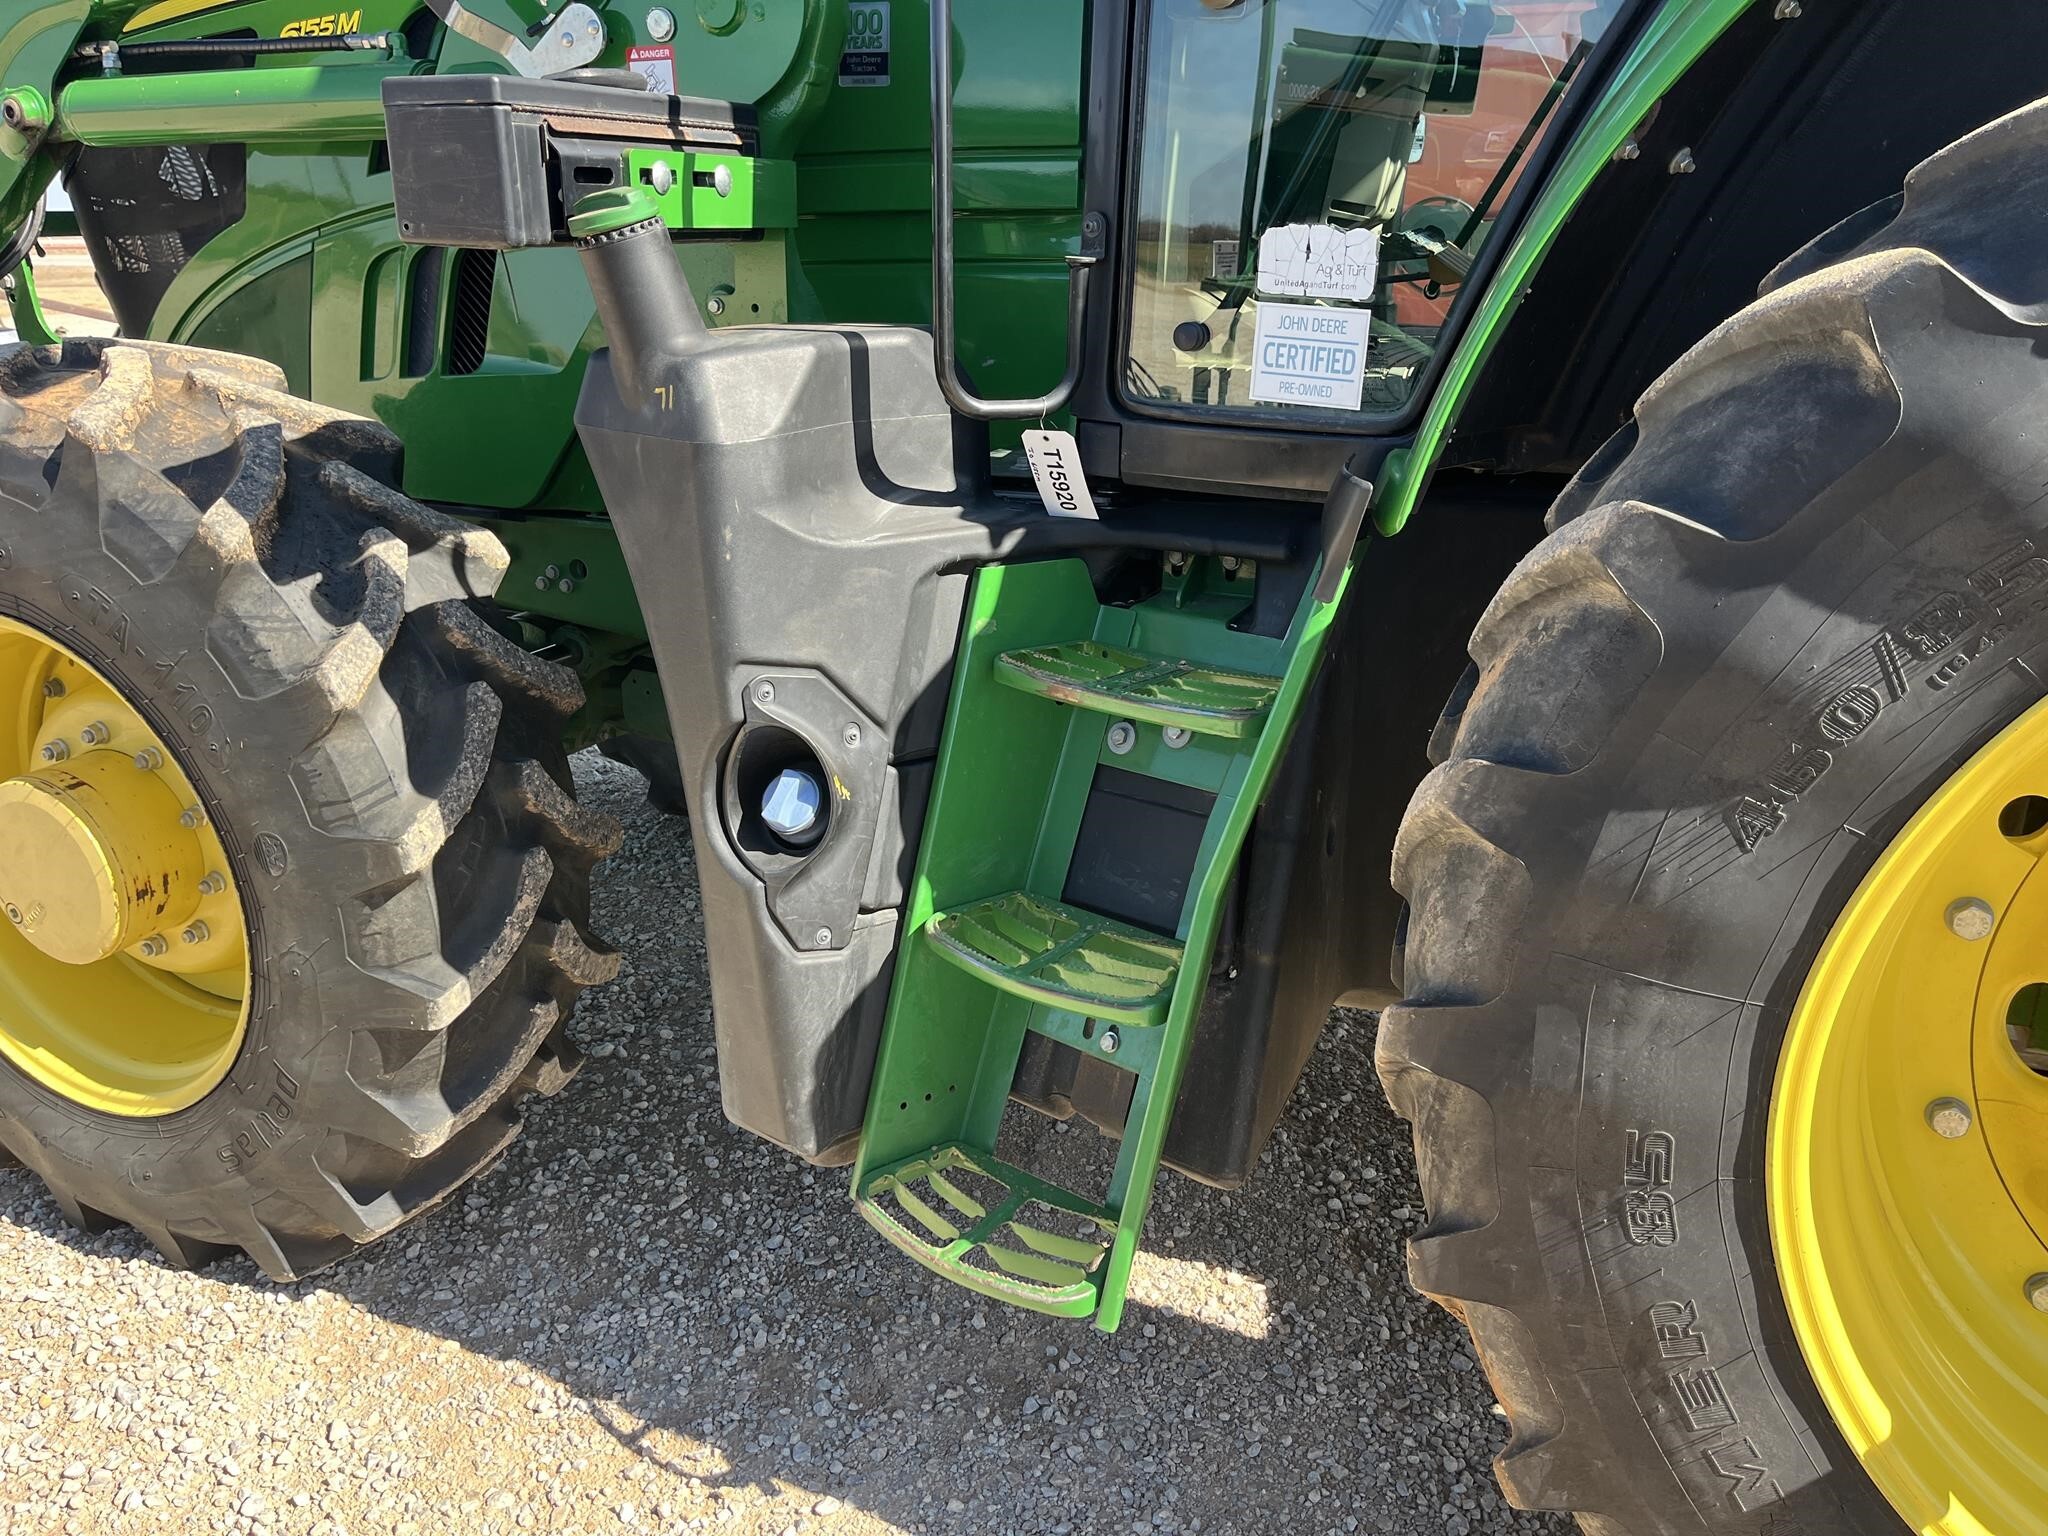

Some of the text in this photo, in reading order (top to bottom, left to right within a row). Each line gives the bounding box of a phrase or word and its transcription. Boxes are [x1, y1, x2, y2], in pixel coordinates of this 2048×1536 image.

[279, 9, 363, 38] 6155M
[640, 48, 670, 59] DANGER
[847, 55, 881, 64] John Deere
[850, 64, 877, 72] Tractors
[1316, 264, 1367, 280] Ag & Turf
[1277, 314, 1349, 336] JOHN DEERE
[1262, 341, 1356, 377] CERTIFIED
[1278, 381, 1333, 399] PRE-OWNED
[1043, 448, 1078, 511] T15920
[86, 584, 215, 736] TA-110
[1622, 1128, 1680, 1248] 85
